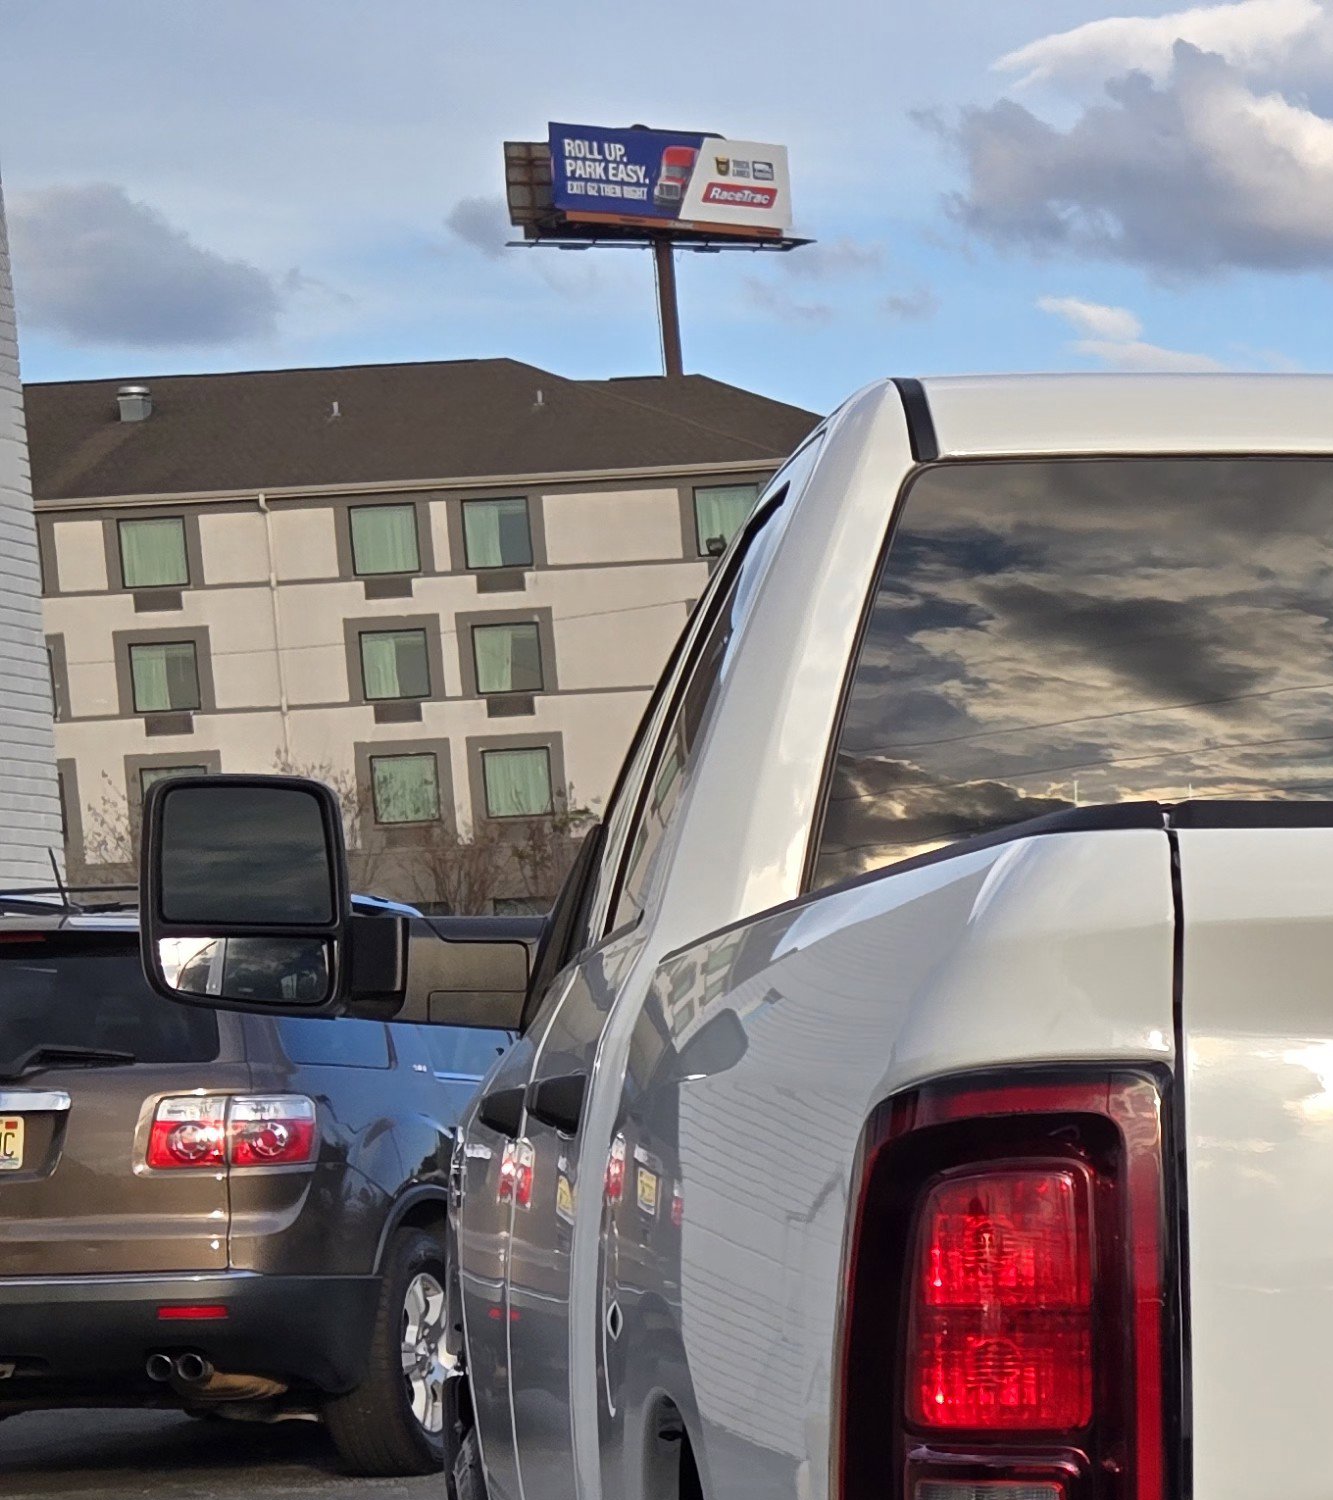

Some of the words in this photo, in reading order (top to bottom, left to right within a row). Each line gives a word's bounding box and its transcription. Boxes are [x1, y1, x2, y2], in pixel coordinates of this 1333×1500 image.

[564, 139, 602, 159] ROLL
[604, 143, 627, 162] UP.
[565, 159, 606, 180] PARK
[608, 163, 649, 184] EASY.
[709, 187, 770, 204] RaceTrac
